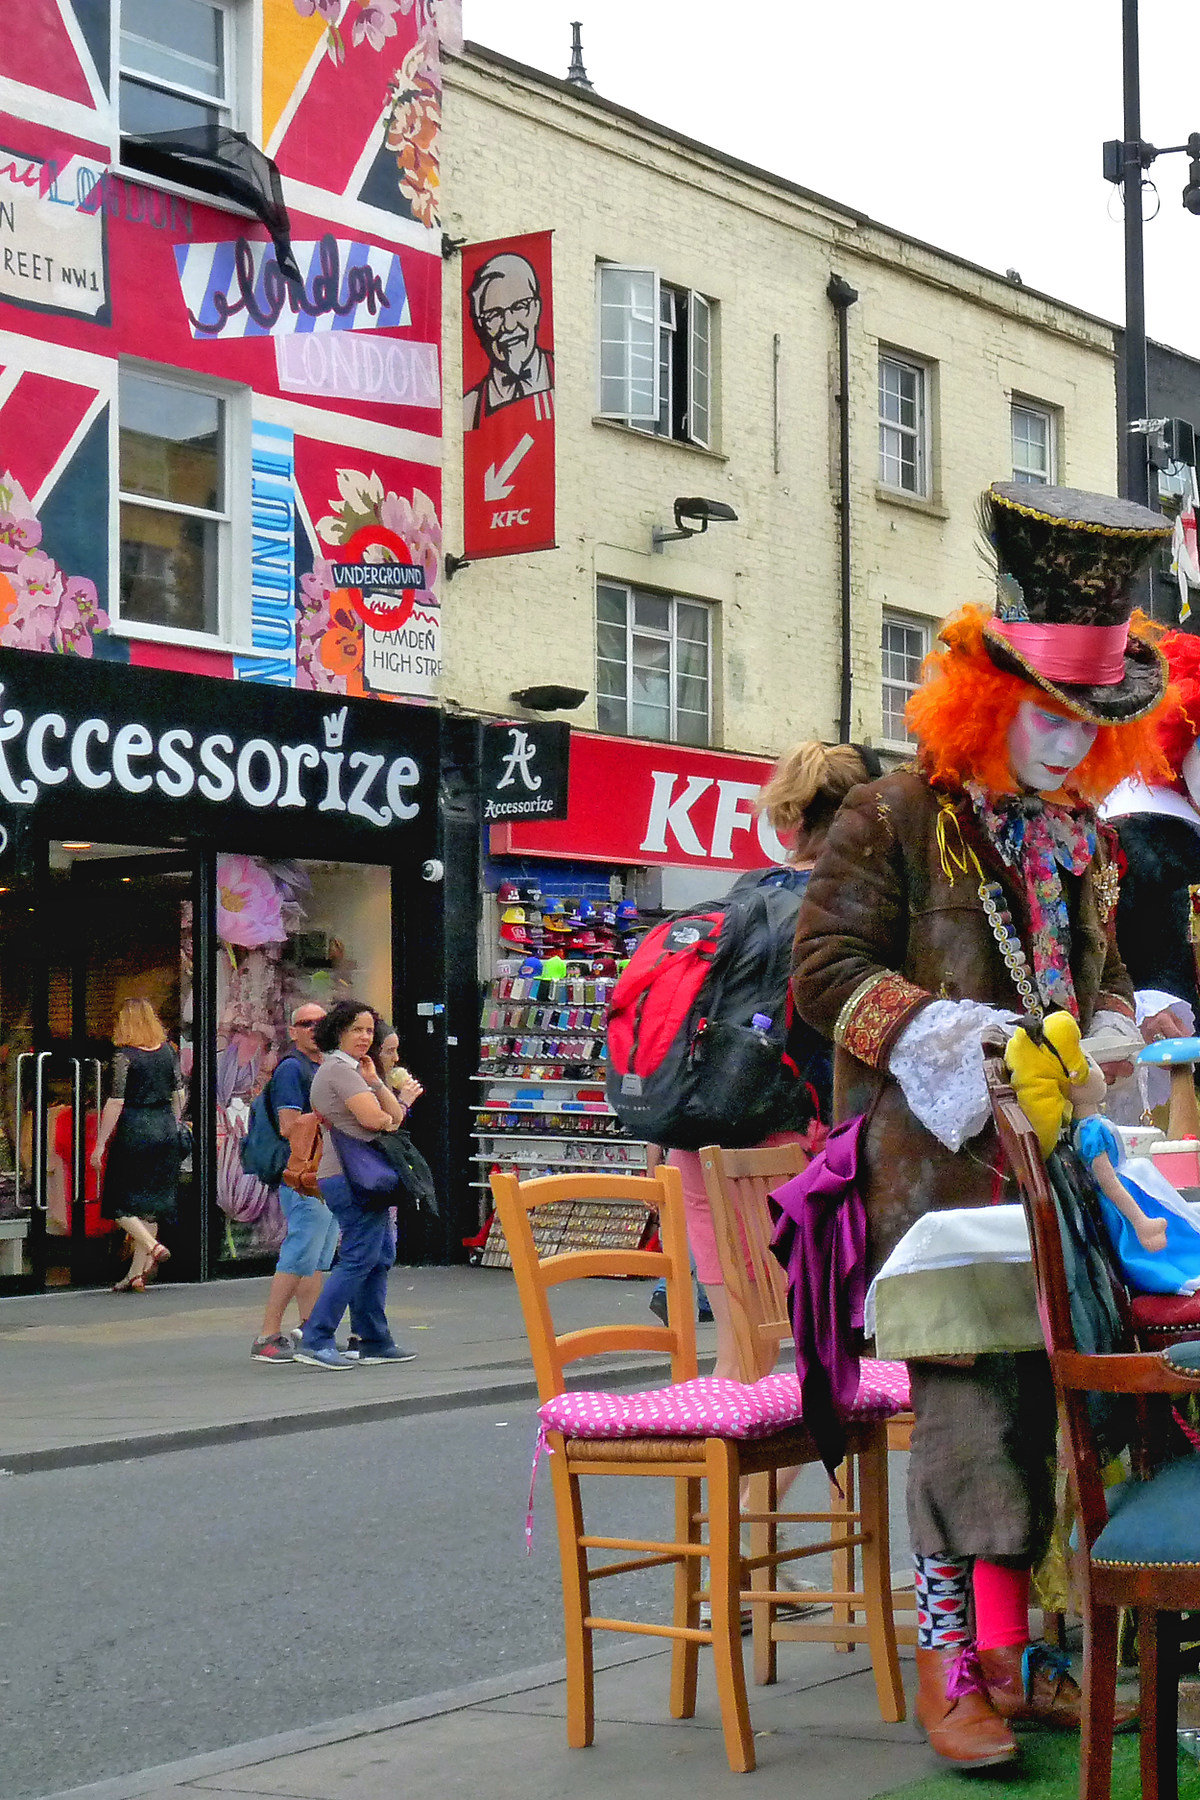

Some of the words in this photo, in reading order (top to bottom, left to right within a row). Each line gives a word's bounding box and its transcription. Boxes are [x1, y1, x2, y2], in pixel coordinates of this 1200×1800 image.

[61, 267, 99, 292] NW1
[279, 332, 440, 404] LONDON
[489, 508, 531, 529] KFC
[332, 564, 424, 586] UNDERGROUND
[373, 628, 435, 651] CAMDEN
[373, 650, 412, 673] HIGH
[497, 728, 542, 790] A
[484, 795, 553, 818] Accessorize
